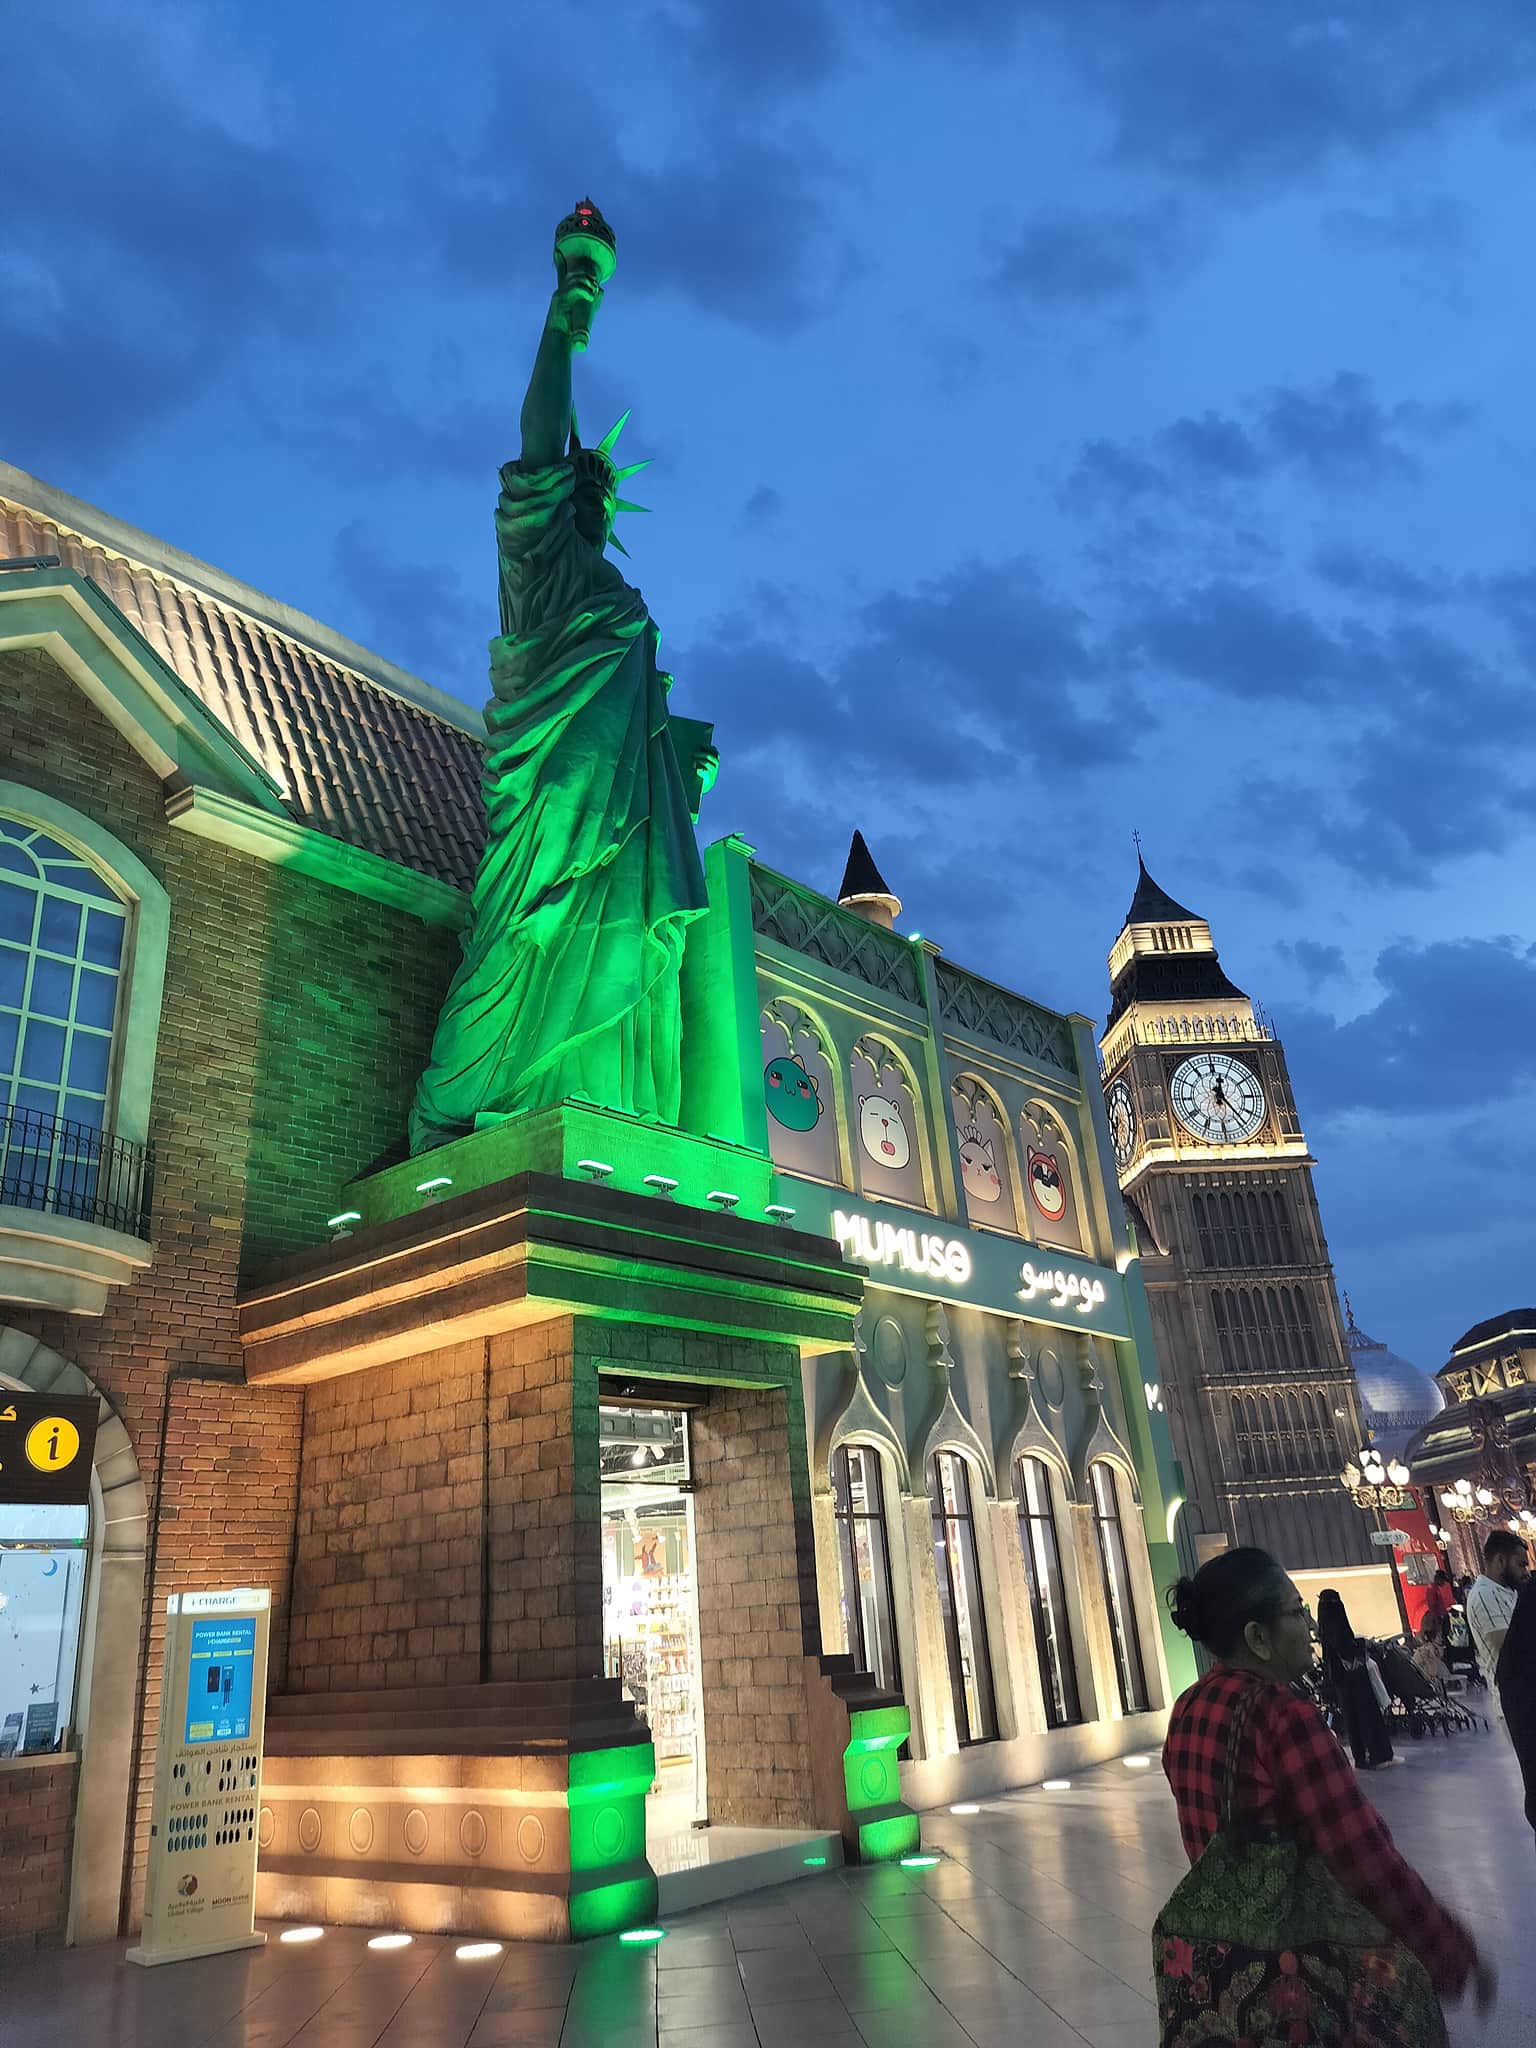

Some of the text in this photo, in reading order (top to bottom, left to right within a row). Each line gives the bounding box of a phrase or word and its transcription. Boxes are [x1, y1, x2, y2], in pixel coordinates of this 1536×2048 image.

[832, 1209, 970, 1283] MUMUSO
[1017, 1262, 1105, 1313] موموسو
[195, 1629, 252, 1639] POWER BANK RENTAL
[170, 1794, 255, 1812] POWER BANK RENTAL
